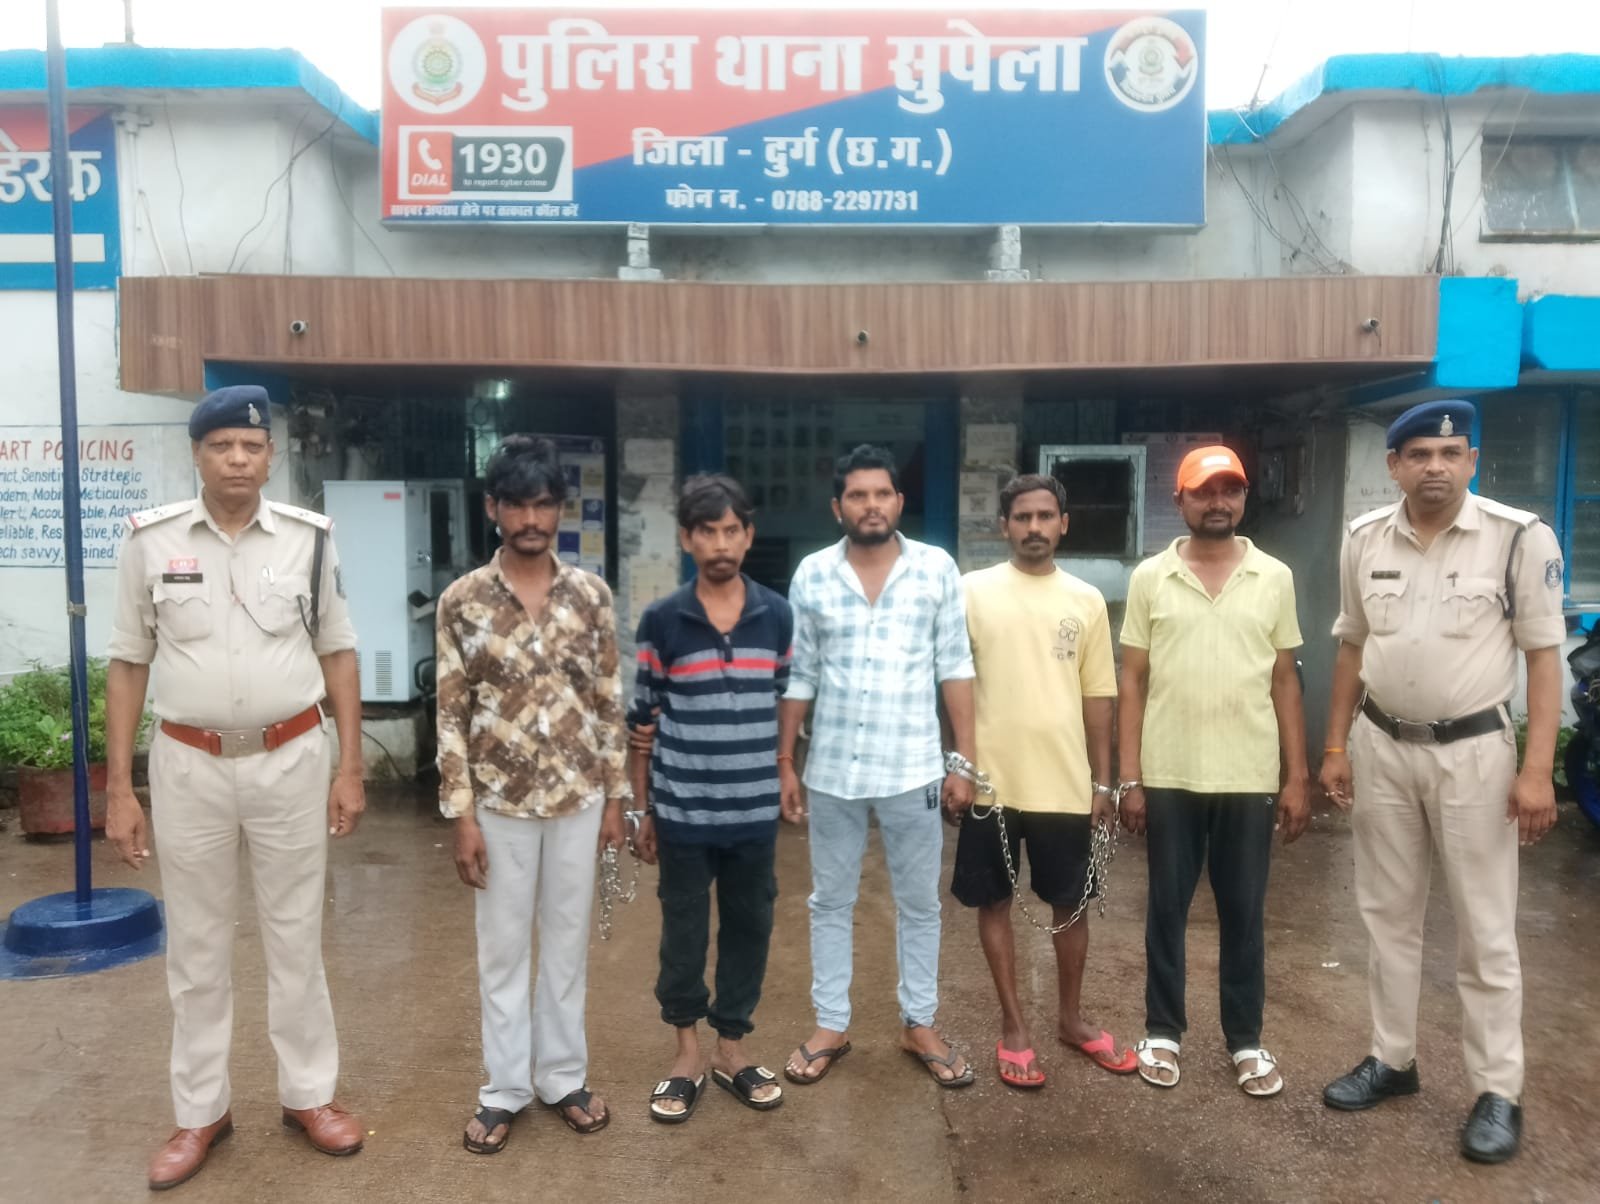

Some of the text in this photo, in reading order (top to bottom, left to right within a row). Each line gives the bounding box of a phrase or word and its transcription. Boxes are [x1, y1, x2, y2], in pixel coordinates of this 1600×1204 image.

[498, 18, 1088, 114] पुलिस थाना सुपेला
[459, 143, 547, 175] 1930
[632, 127, 728, 166] जिला
[763, 127, 820, 178] दुर्ग
[411, 173, 448, 187] DIAL
[473, 179, 498, 188] report
[500, 179, 523, 188] cyber
[665, 183, 714, 210] फोन
[43, 439, 134, 461] POICING
[81, 467, 142, 486] Strategic
[30, 504, 108, 519] Accouable,
